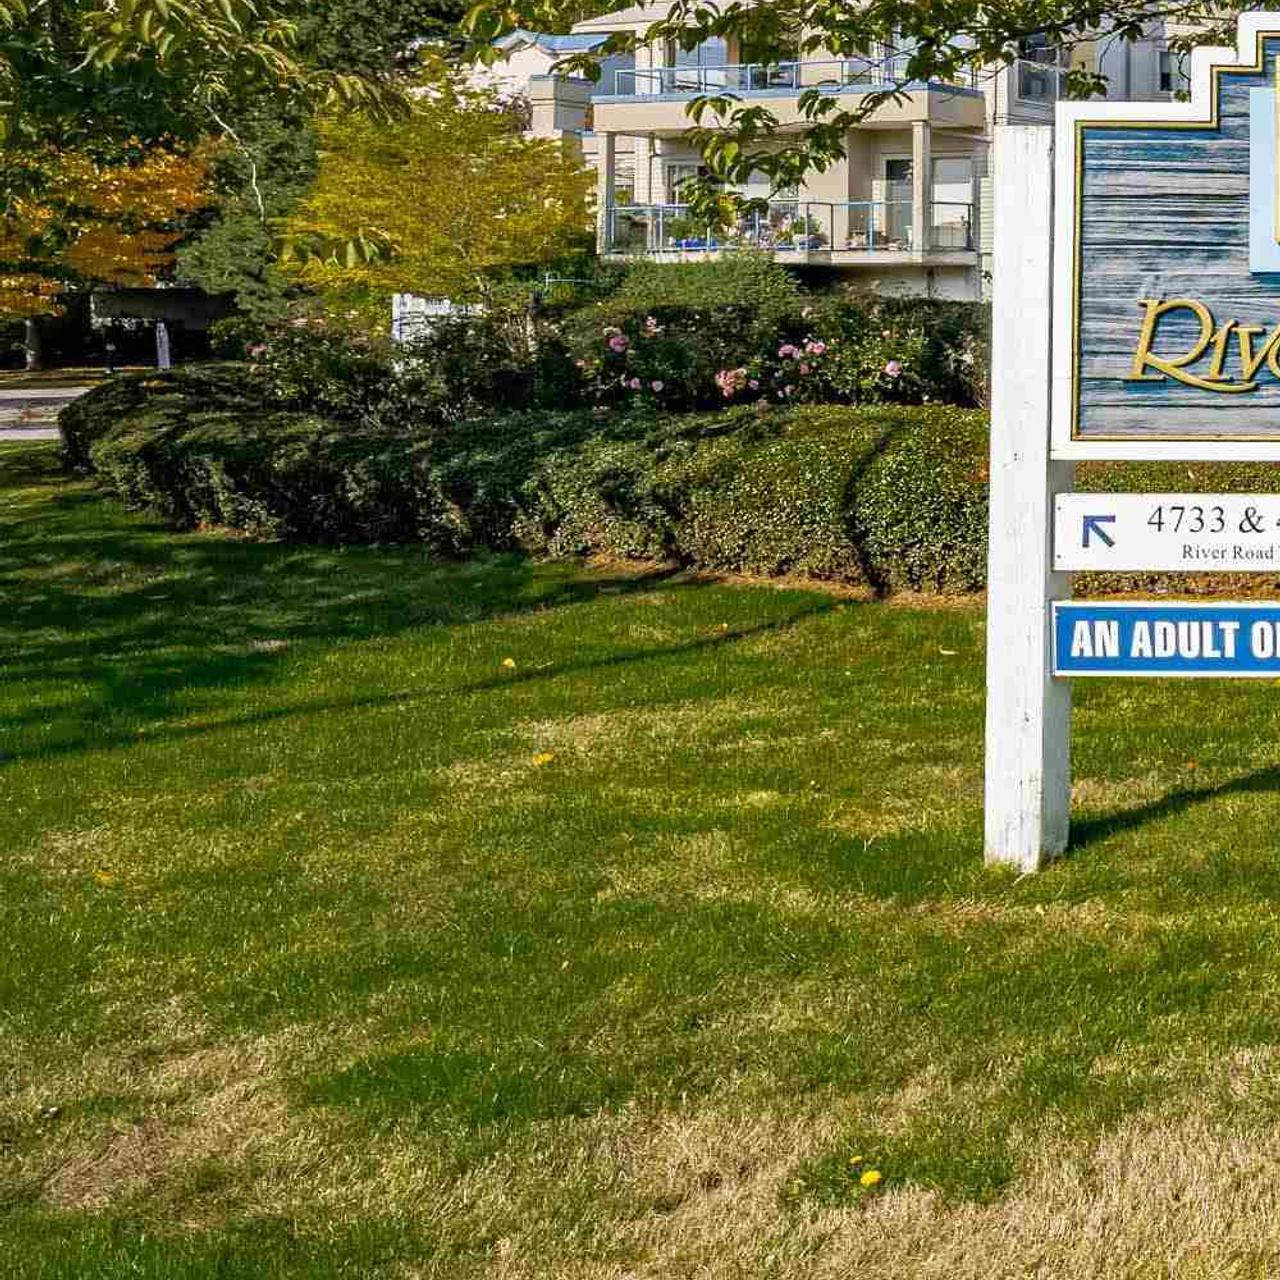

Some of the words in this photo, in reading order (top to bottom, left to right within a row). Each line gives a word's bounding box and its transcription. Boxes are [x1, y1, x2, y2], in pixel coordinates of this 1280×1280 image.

[1146, 505, 1226, 534] 4733
[1238, 506, 1266, 534] &
[1181, 544, 1228, 561] River
[1232, 544, 1275, 561] Road
[1070, 620, 1120, 659] AN
[1130, 620, 1241, 659] ADULT
